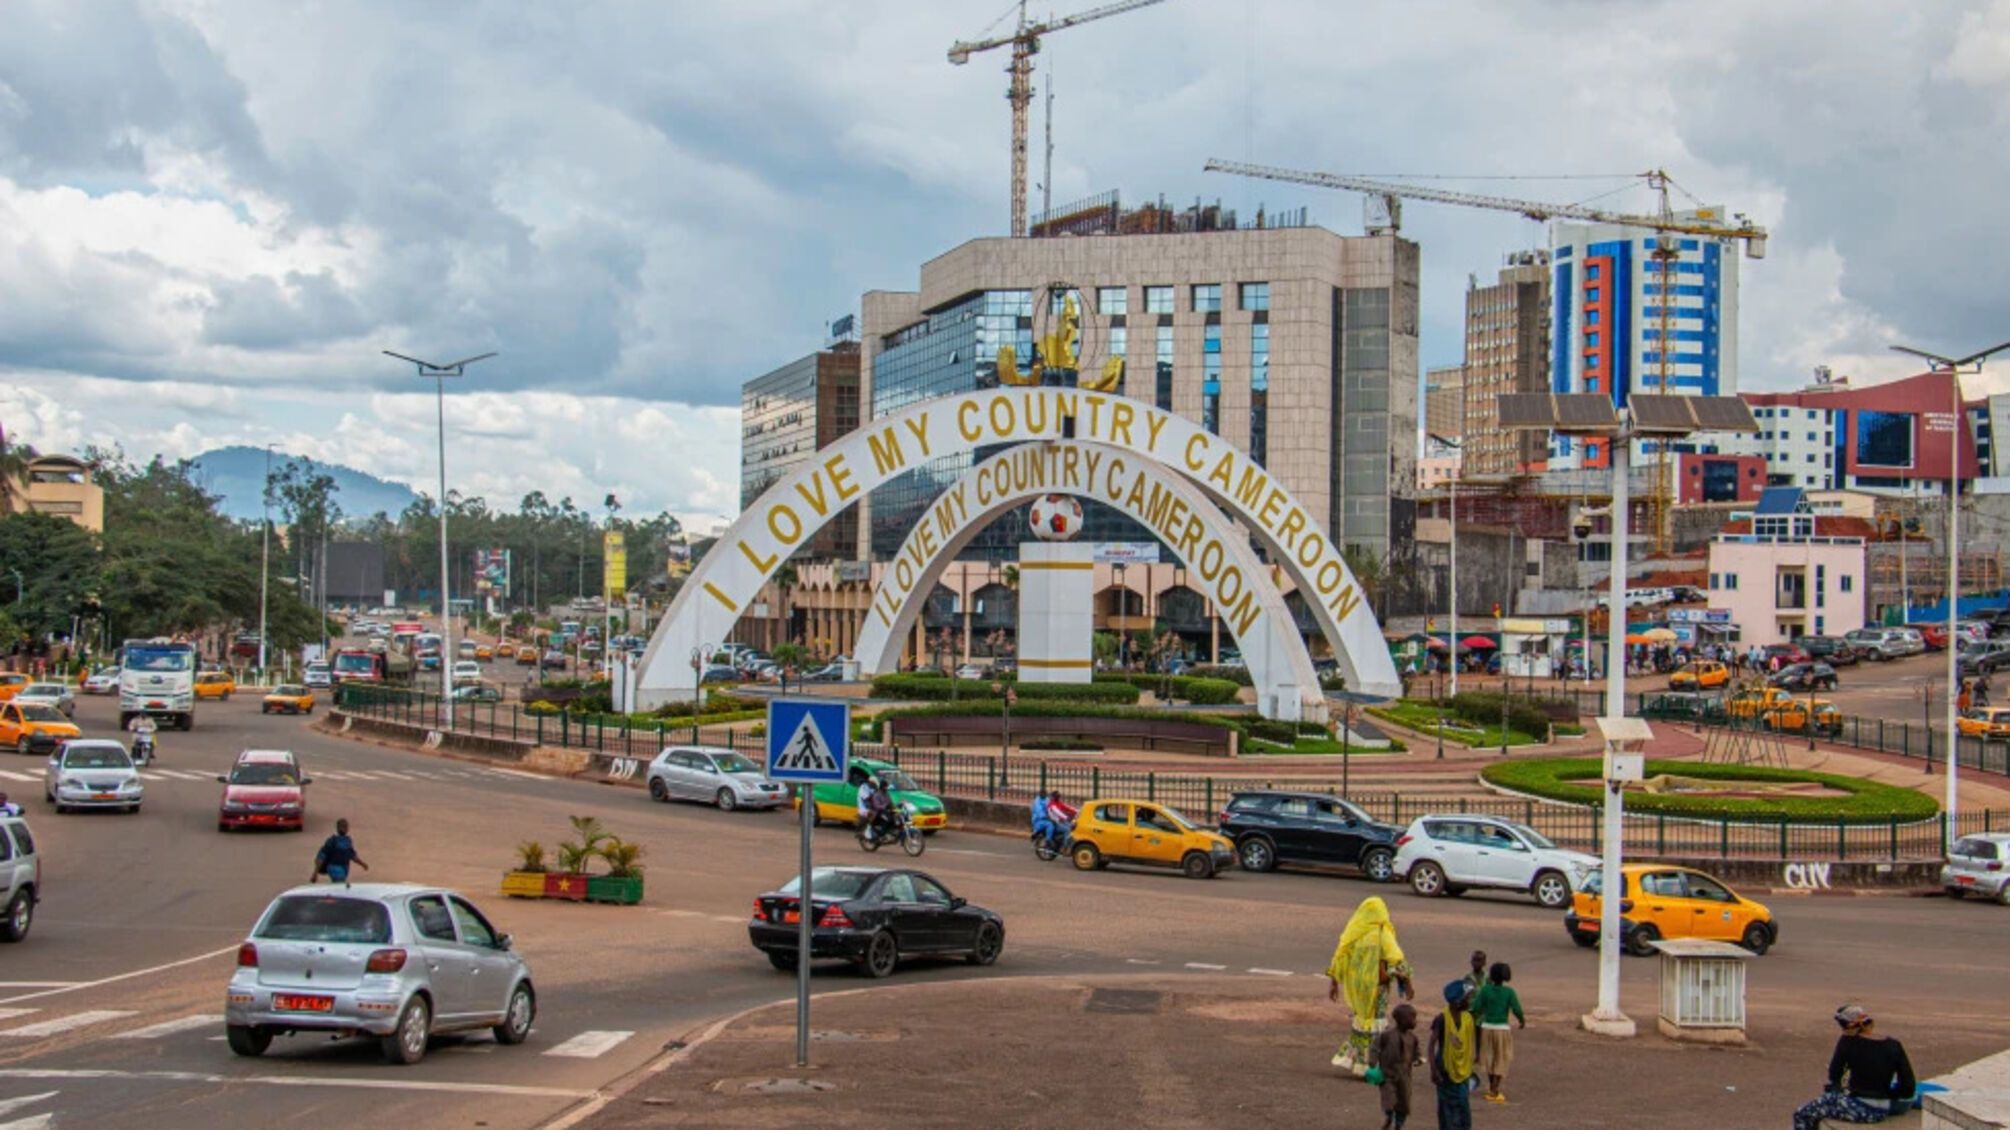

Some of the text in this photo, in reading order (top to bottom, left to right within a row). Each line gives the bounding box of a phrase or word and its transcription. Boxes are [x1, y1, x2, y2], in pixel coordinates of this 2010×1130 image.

[704, 392, 1361, 624] I LOVE MY COUNTRY CAMEROON
[874, 445, 1262, 638] I LOVE MY COUNTRY CAMEROON
